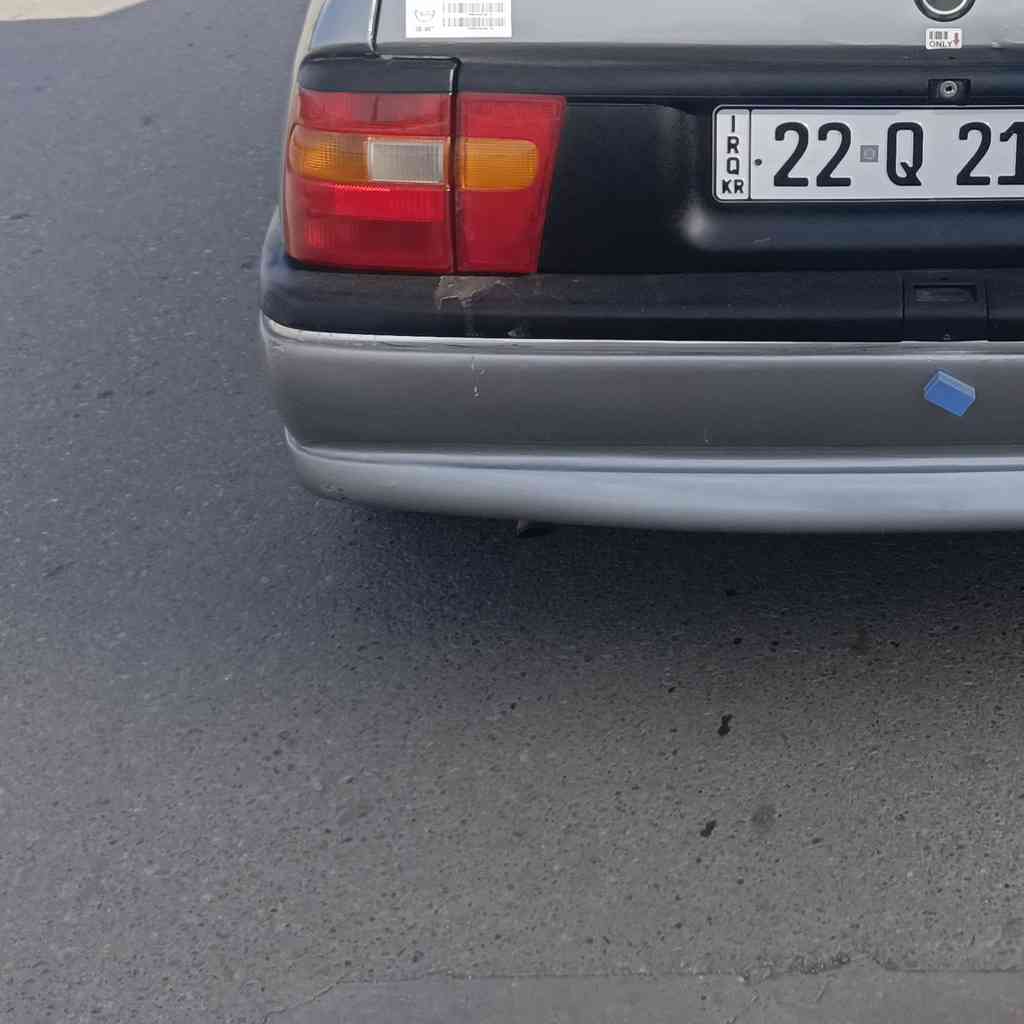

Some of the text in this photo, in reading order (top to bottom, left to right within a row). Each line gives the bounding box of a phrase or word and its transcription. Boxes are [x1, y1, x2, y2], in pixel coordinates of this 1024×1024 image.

[774, 122, 851, 187] 22
[887, 121, 925, 187] Q
[721, 179, 745, 195] KR
